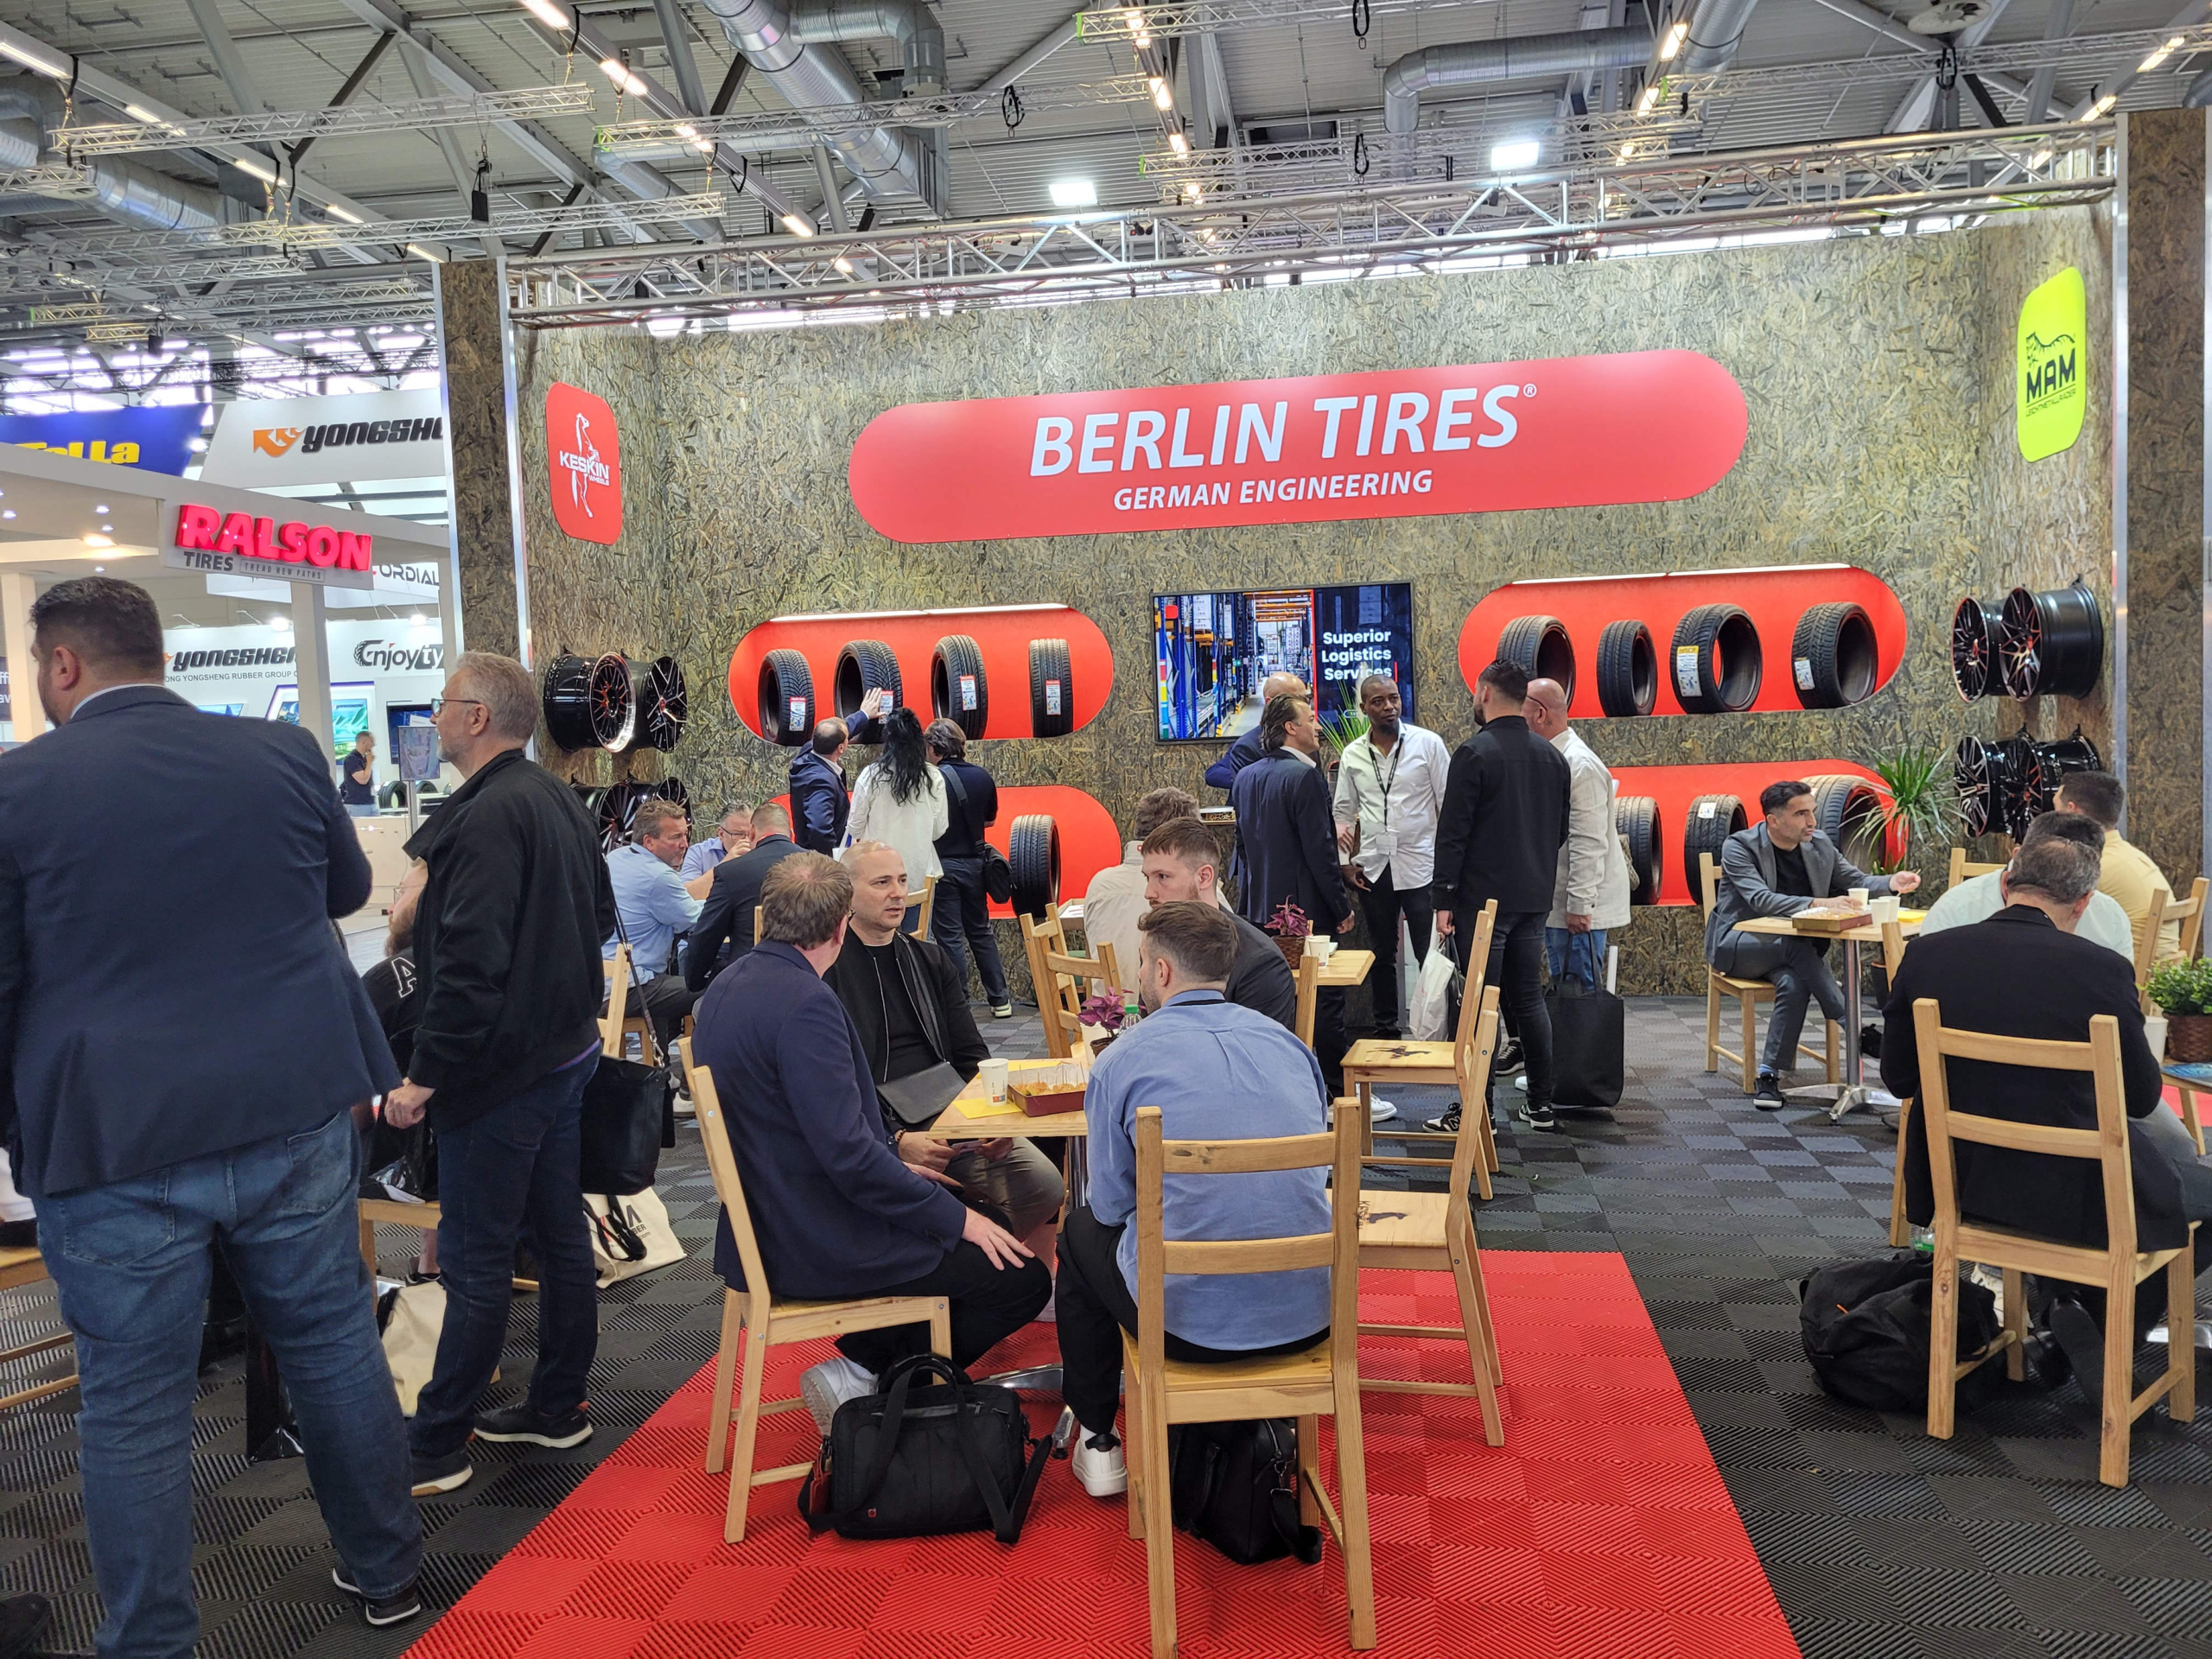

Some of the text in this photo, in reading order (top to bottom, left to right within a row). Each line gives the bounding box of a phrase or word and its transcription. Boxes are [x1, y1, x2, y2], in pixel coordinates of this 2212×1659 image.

[2026, 347, 2075, 404] MAM
[1029, 401, 1288, 477] BERLIN
[559, 450, 610, 480] KESKIN
[588, 475, 610, 486] WHEELS
[1112, 469, 1433, 511] GERMAN ENGINEERING
[175, 504, 372, 572] RALSON
[183, 551, 234, 572] TIRES
[245, 562, 322, 580] TREAD NEW PATHS
[372, 563, 440, 586] ORDIAL
[1323, 628, 1392, 648] Superior
[1321, 646, 1392, 666] Logistics
[182, 673, 231, 682] YONGSHENG
[232, 671, 264, 680] RUBBER
